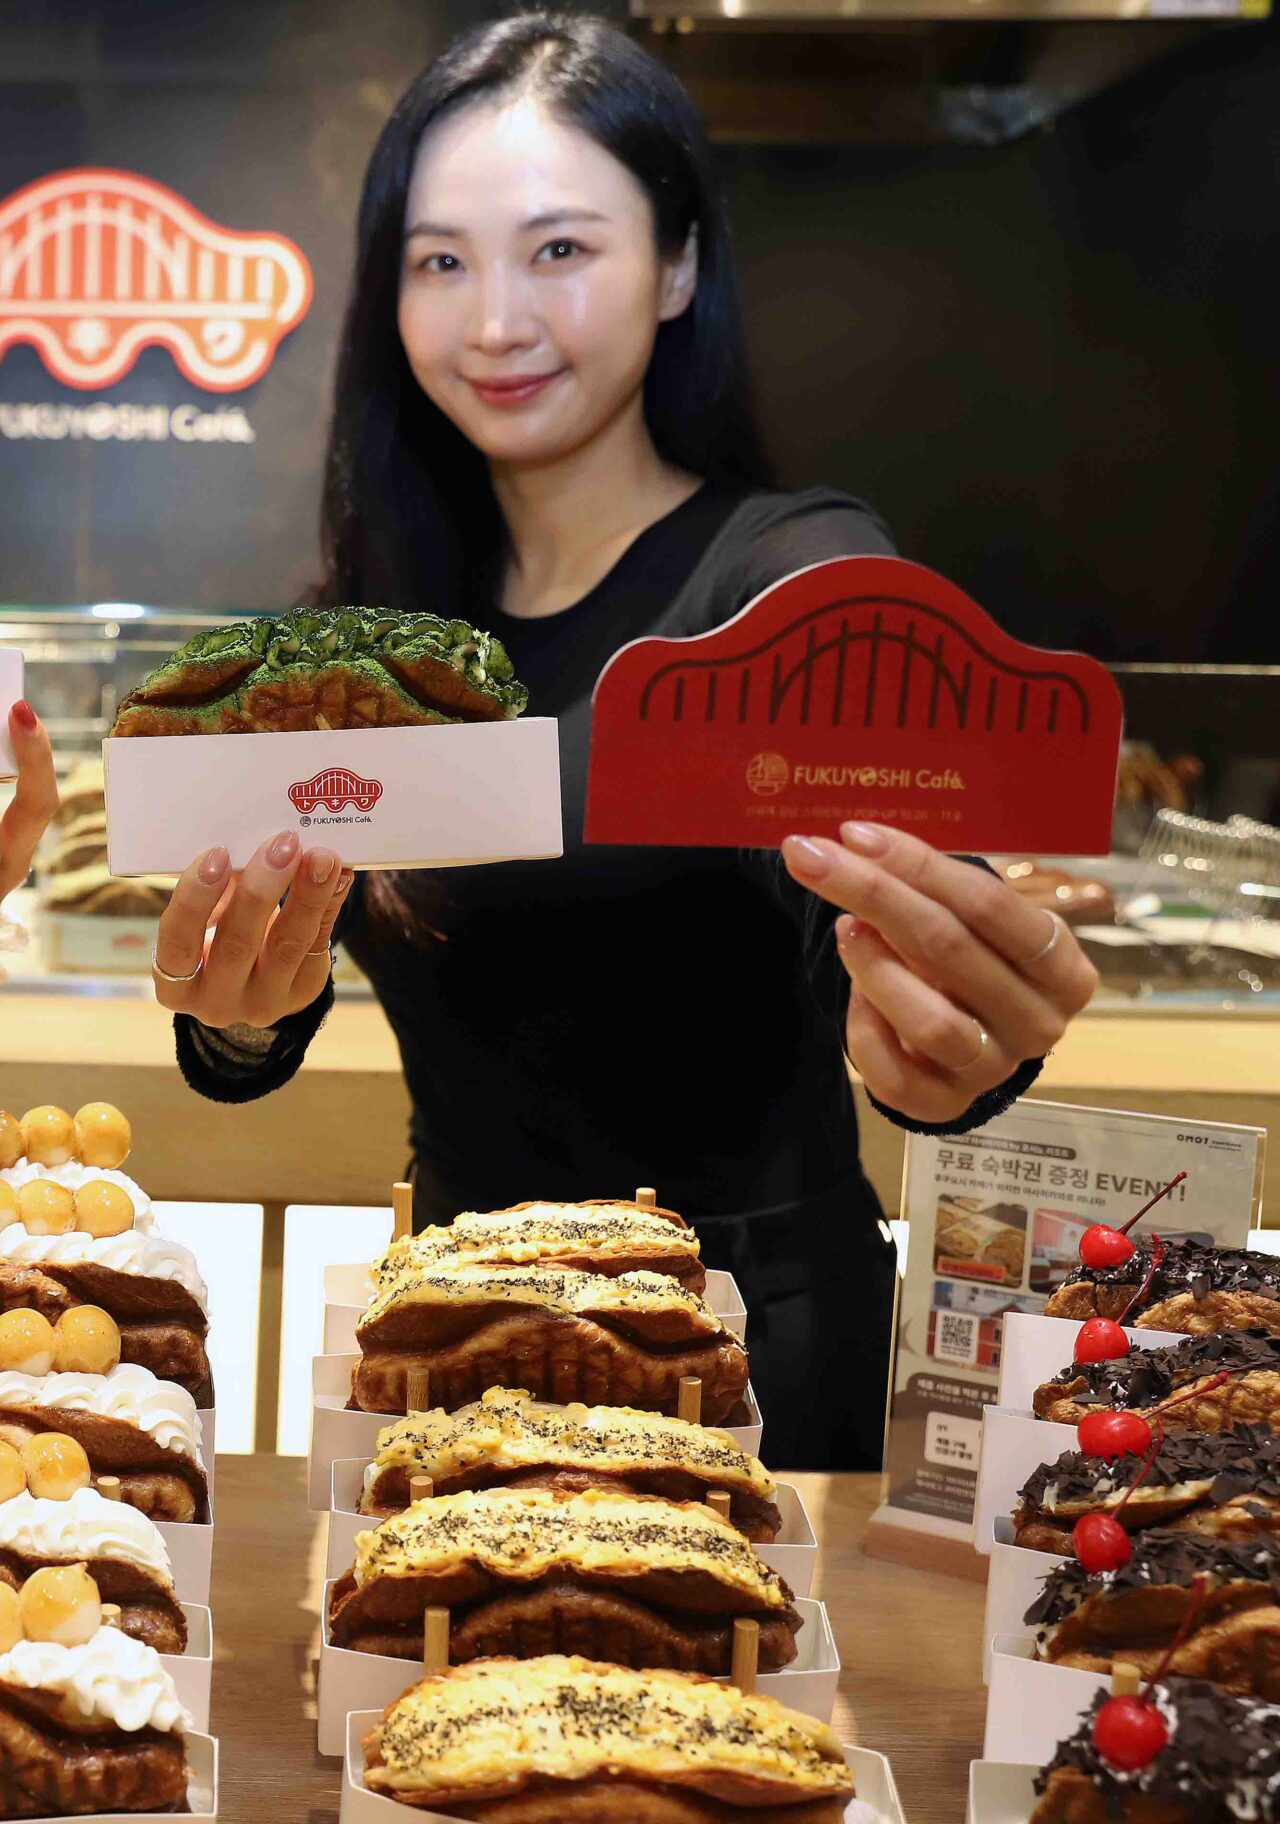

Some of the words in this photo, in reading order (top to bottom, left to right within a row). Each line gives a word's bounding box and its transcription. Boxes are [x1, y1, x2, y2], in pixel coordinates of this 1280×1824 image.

[794, 766, 910, 788] FUKUYOSHI
[303, 797, 369, 809] トキワ
[313, 817, 354, 825] FUKUYOSHI
[936, 1149, 975, 1171] 무료
[981, 1156, 1041, 1183] 숙박권
[1048, 1164, 1088, 1190] 증정
[1095, 1173, 1187, 1202] EVENT!
